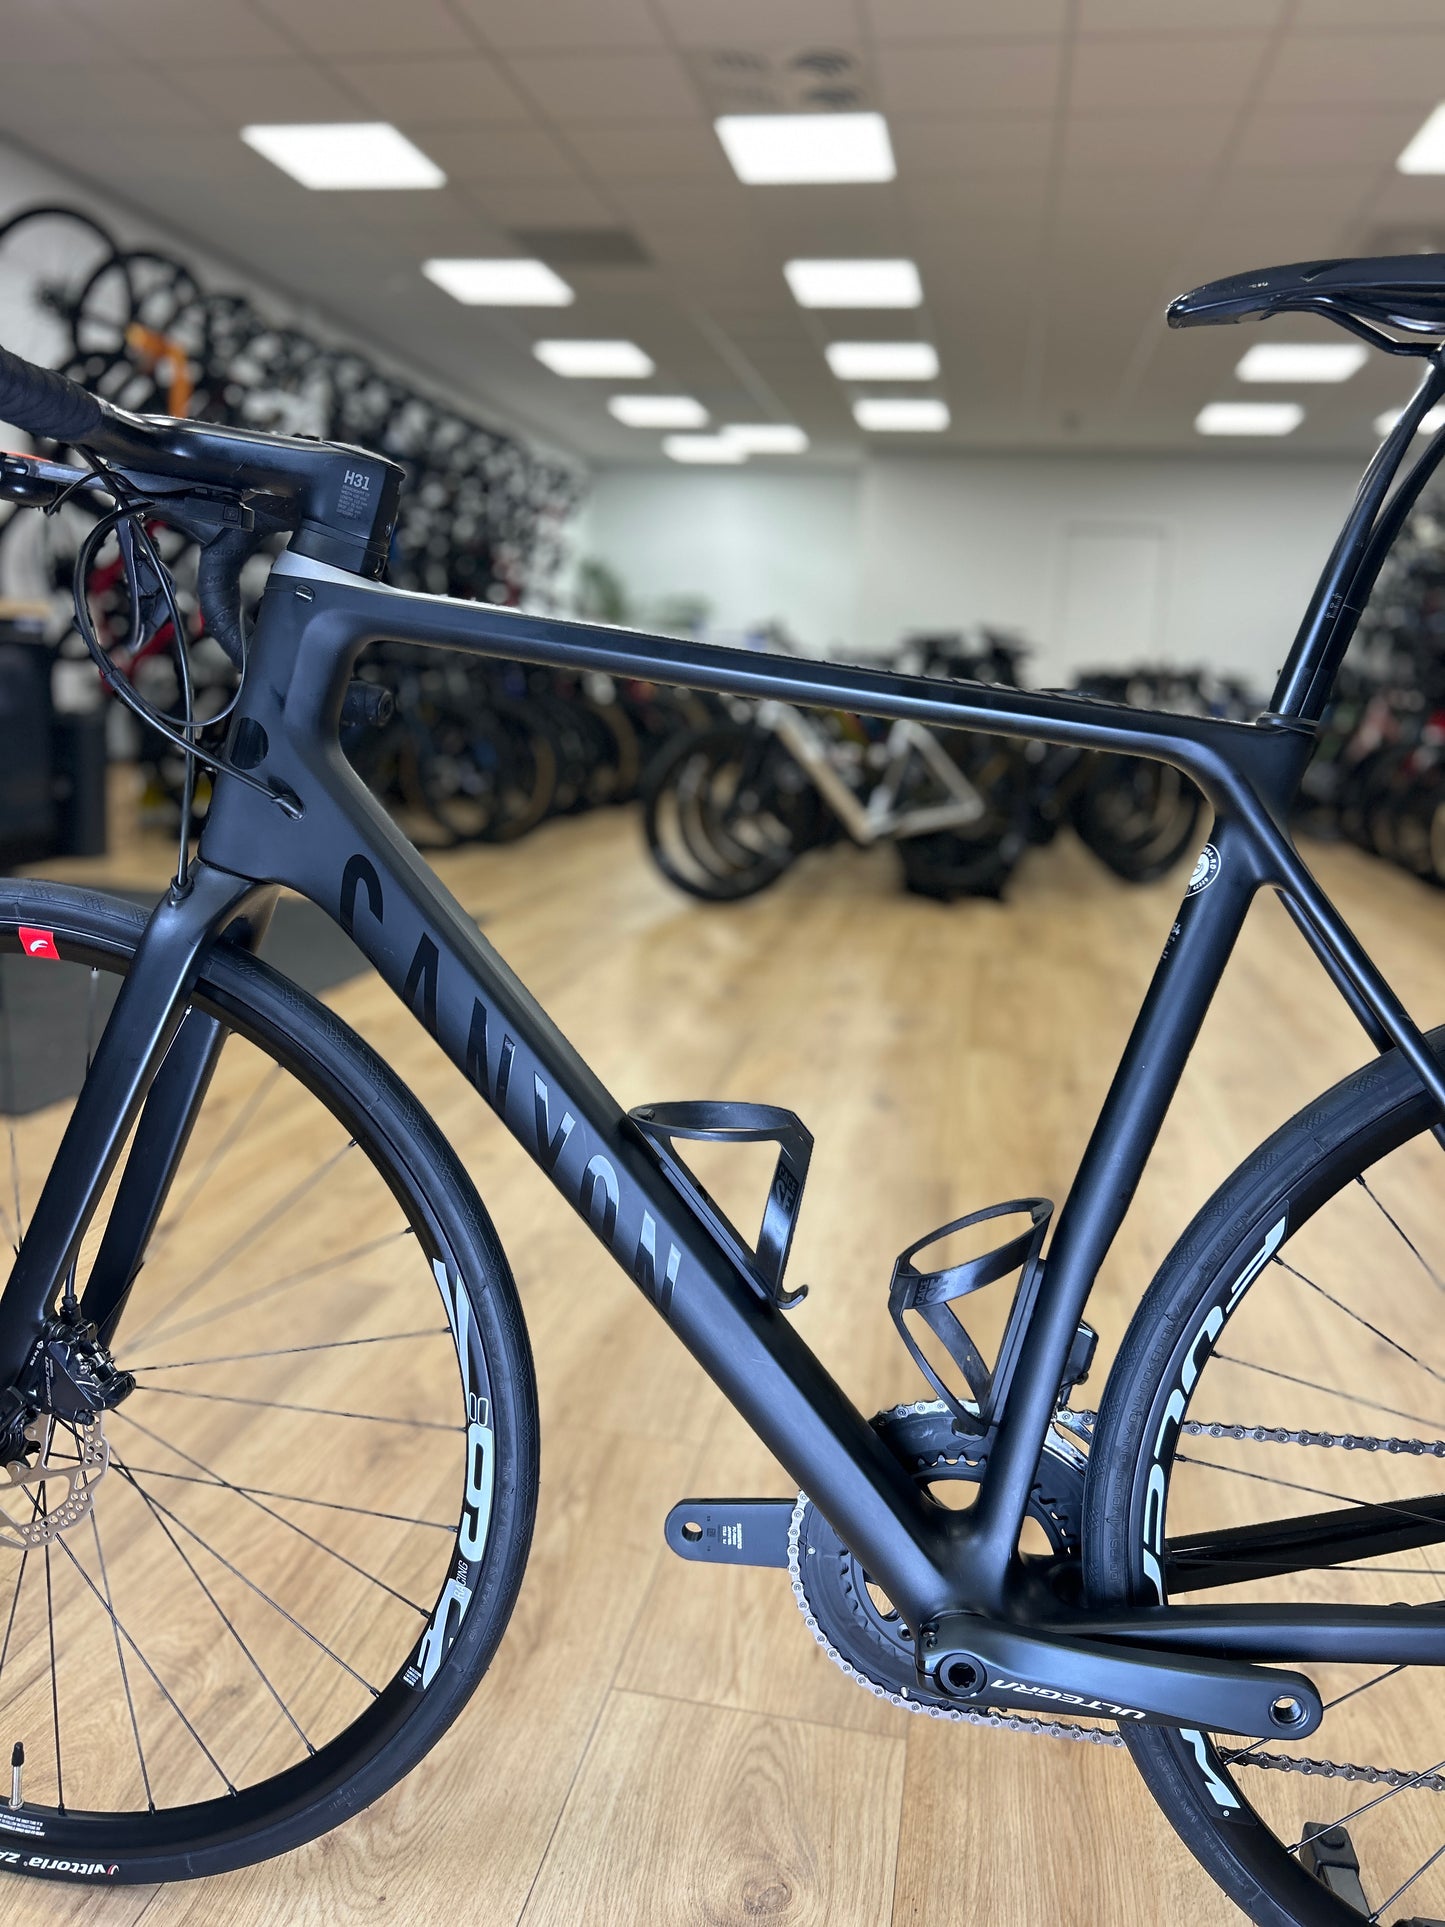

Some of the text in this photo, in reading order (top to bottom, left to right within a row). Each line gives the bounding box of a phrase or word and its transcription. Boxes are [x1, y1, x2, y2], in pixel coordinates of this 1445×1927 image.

[343, 470, 370, 491] H31
[339, 854, 682, 1320] CANYON
[1201, 1210, 1251, 1274] ROTATION
[1120, 1427, 1134, 1464] ONLY
[453, 1559, 469, 1600] RACING
[990, 1679, 1147, 1720] ULTEGRA
[28, 1857, 106, 1875] vittoria
